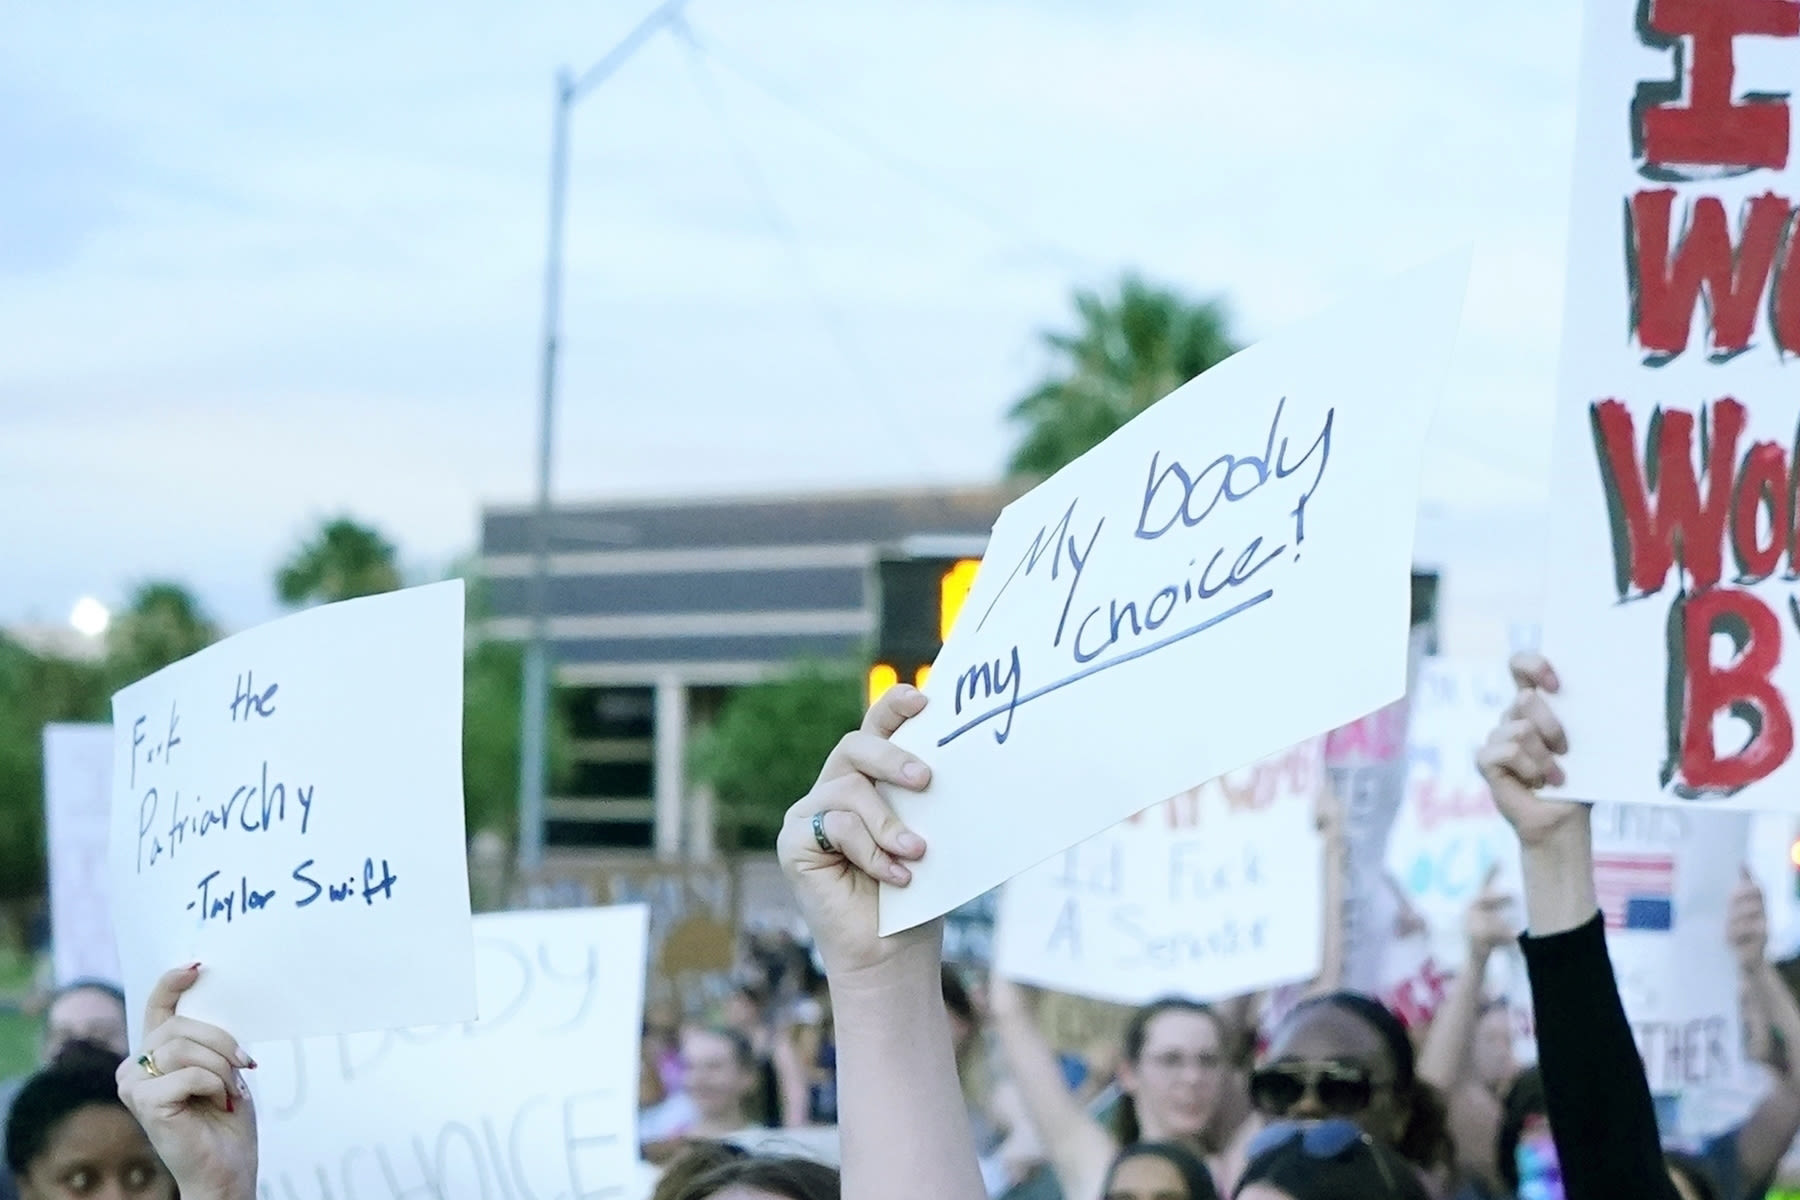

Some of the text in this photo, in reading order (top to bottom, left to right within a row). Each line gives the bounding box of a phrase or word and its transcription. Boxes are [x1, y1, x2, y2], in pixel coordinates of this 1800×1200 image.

[976, 397, 1335, 648] My body
[230, 670, 280, 724] the
[955, 645, 1021, 744] my
[137, 761, 315, 875] Patriarchy
[295, 858, 398, 909] Swift
